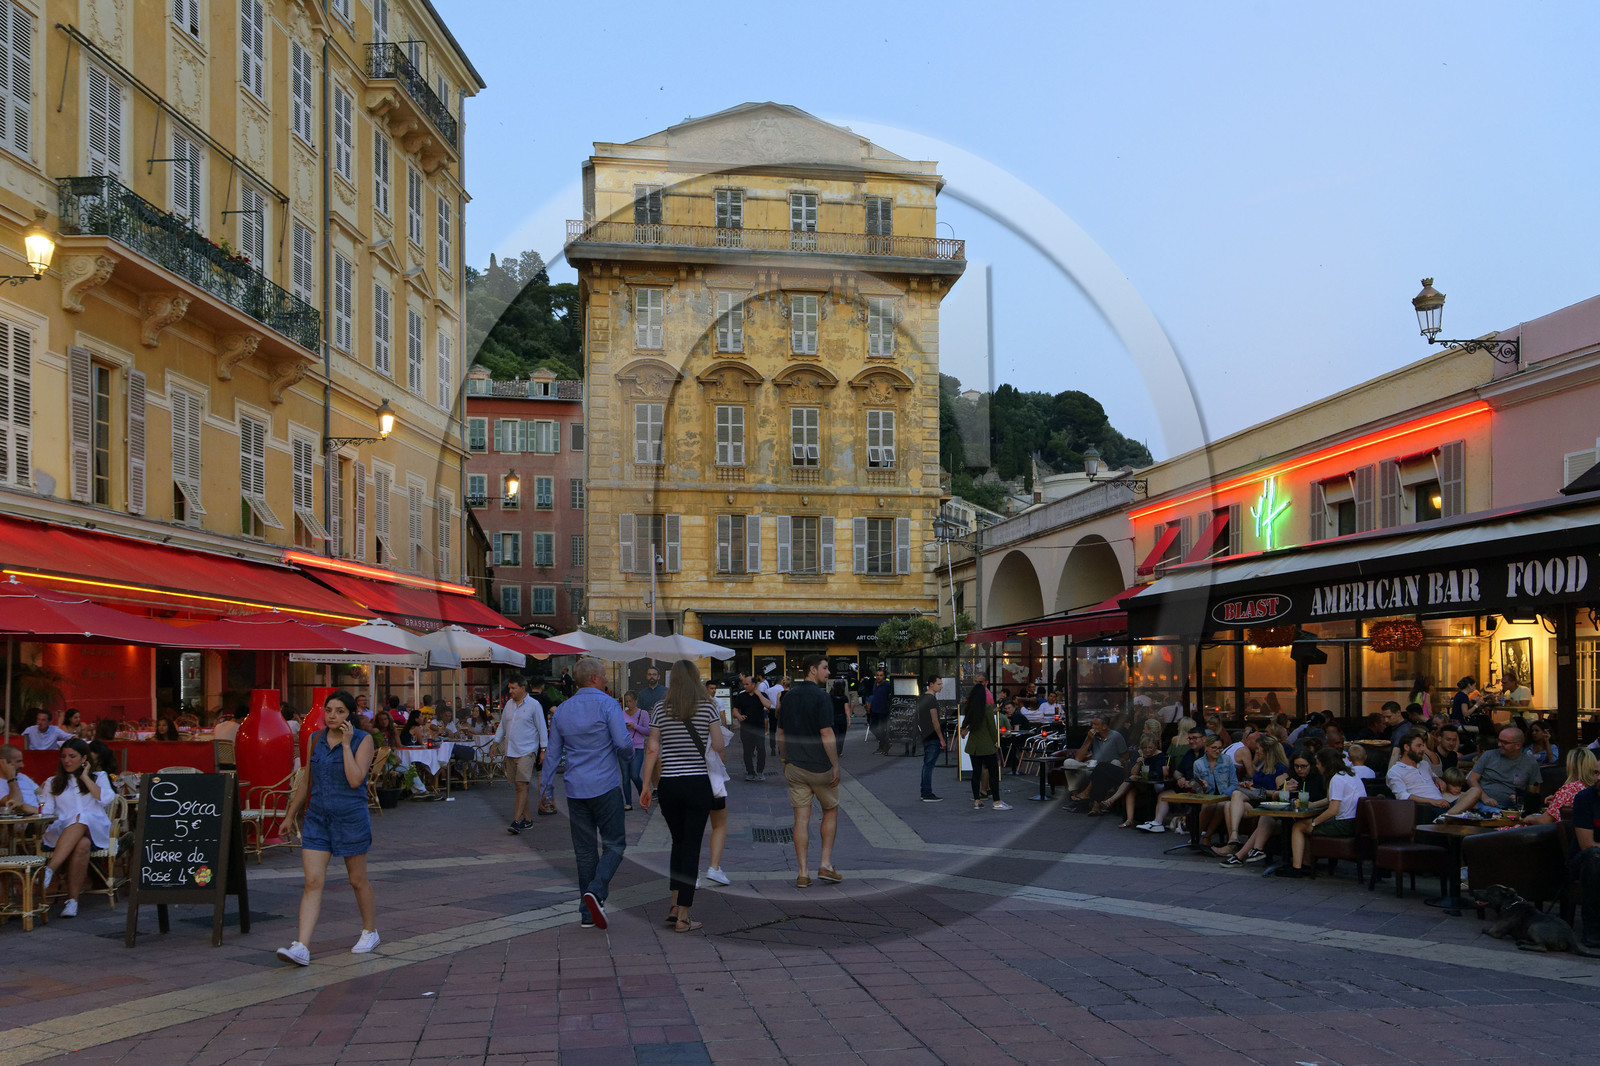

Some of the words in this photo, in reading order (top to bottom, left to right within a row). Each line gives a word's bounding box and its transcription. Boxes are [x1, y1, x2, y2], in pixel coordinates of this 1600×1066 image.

[1310, 575, 1421, 616] AMERICAN
[1427, 568, 1481, 605] BAR
[1506, 555, 1589, 598] FOOD
[1223, 597, 1280, 620] BLAST
[404, 618, 440, 630] BRASSERIE
[709, 629, 754, 641] GALERIE
[758, 629, 772, 641] LE
[777, 629, 835, 641] CONTAINER
[150, 781, 221, 818] Socca
[173, 819, 202, 838] 5€
[187, 846, 208, 864] de
[141, 866, 173, 884] Rosé
